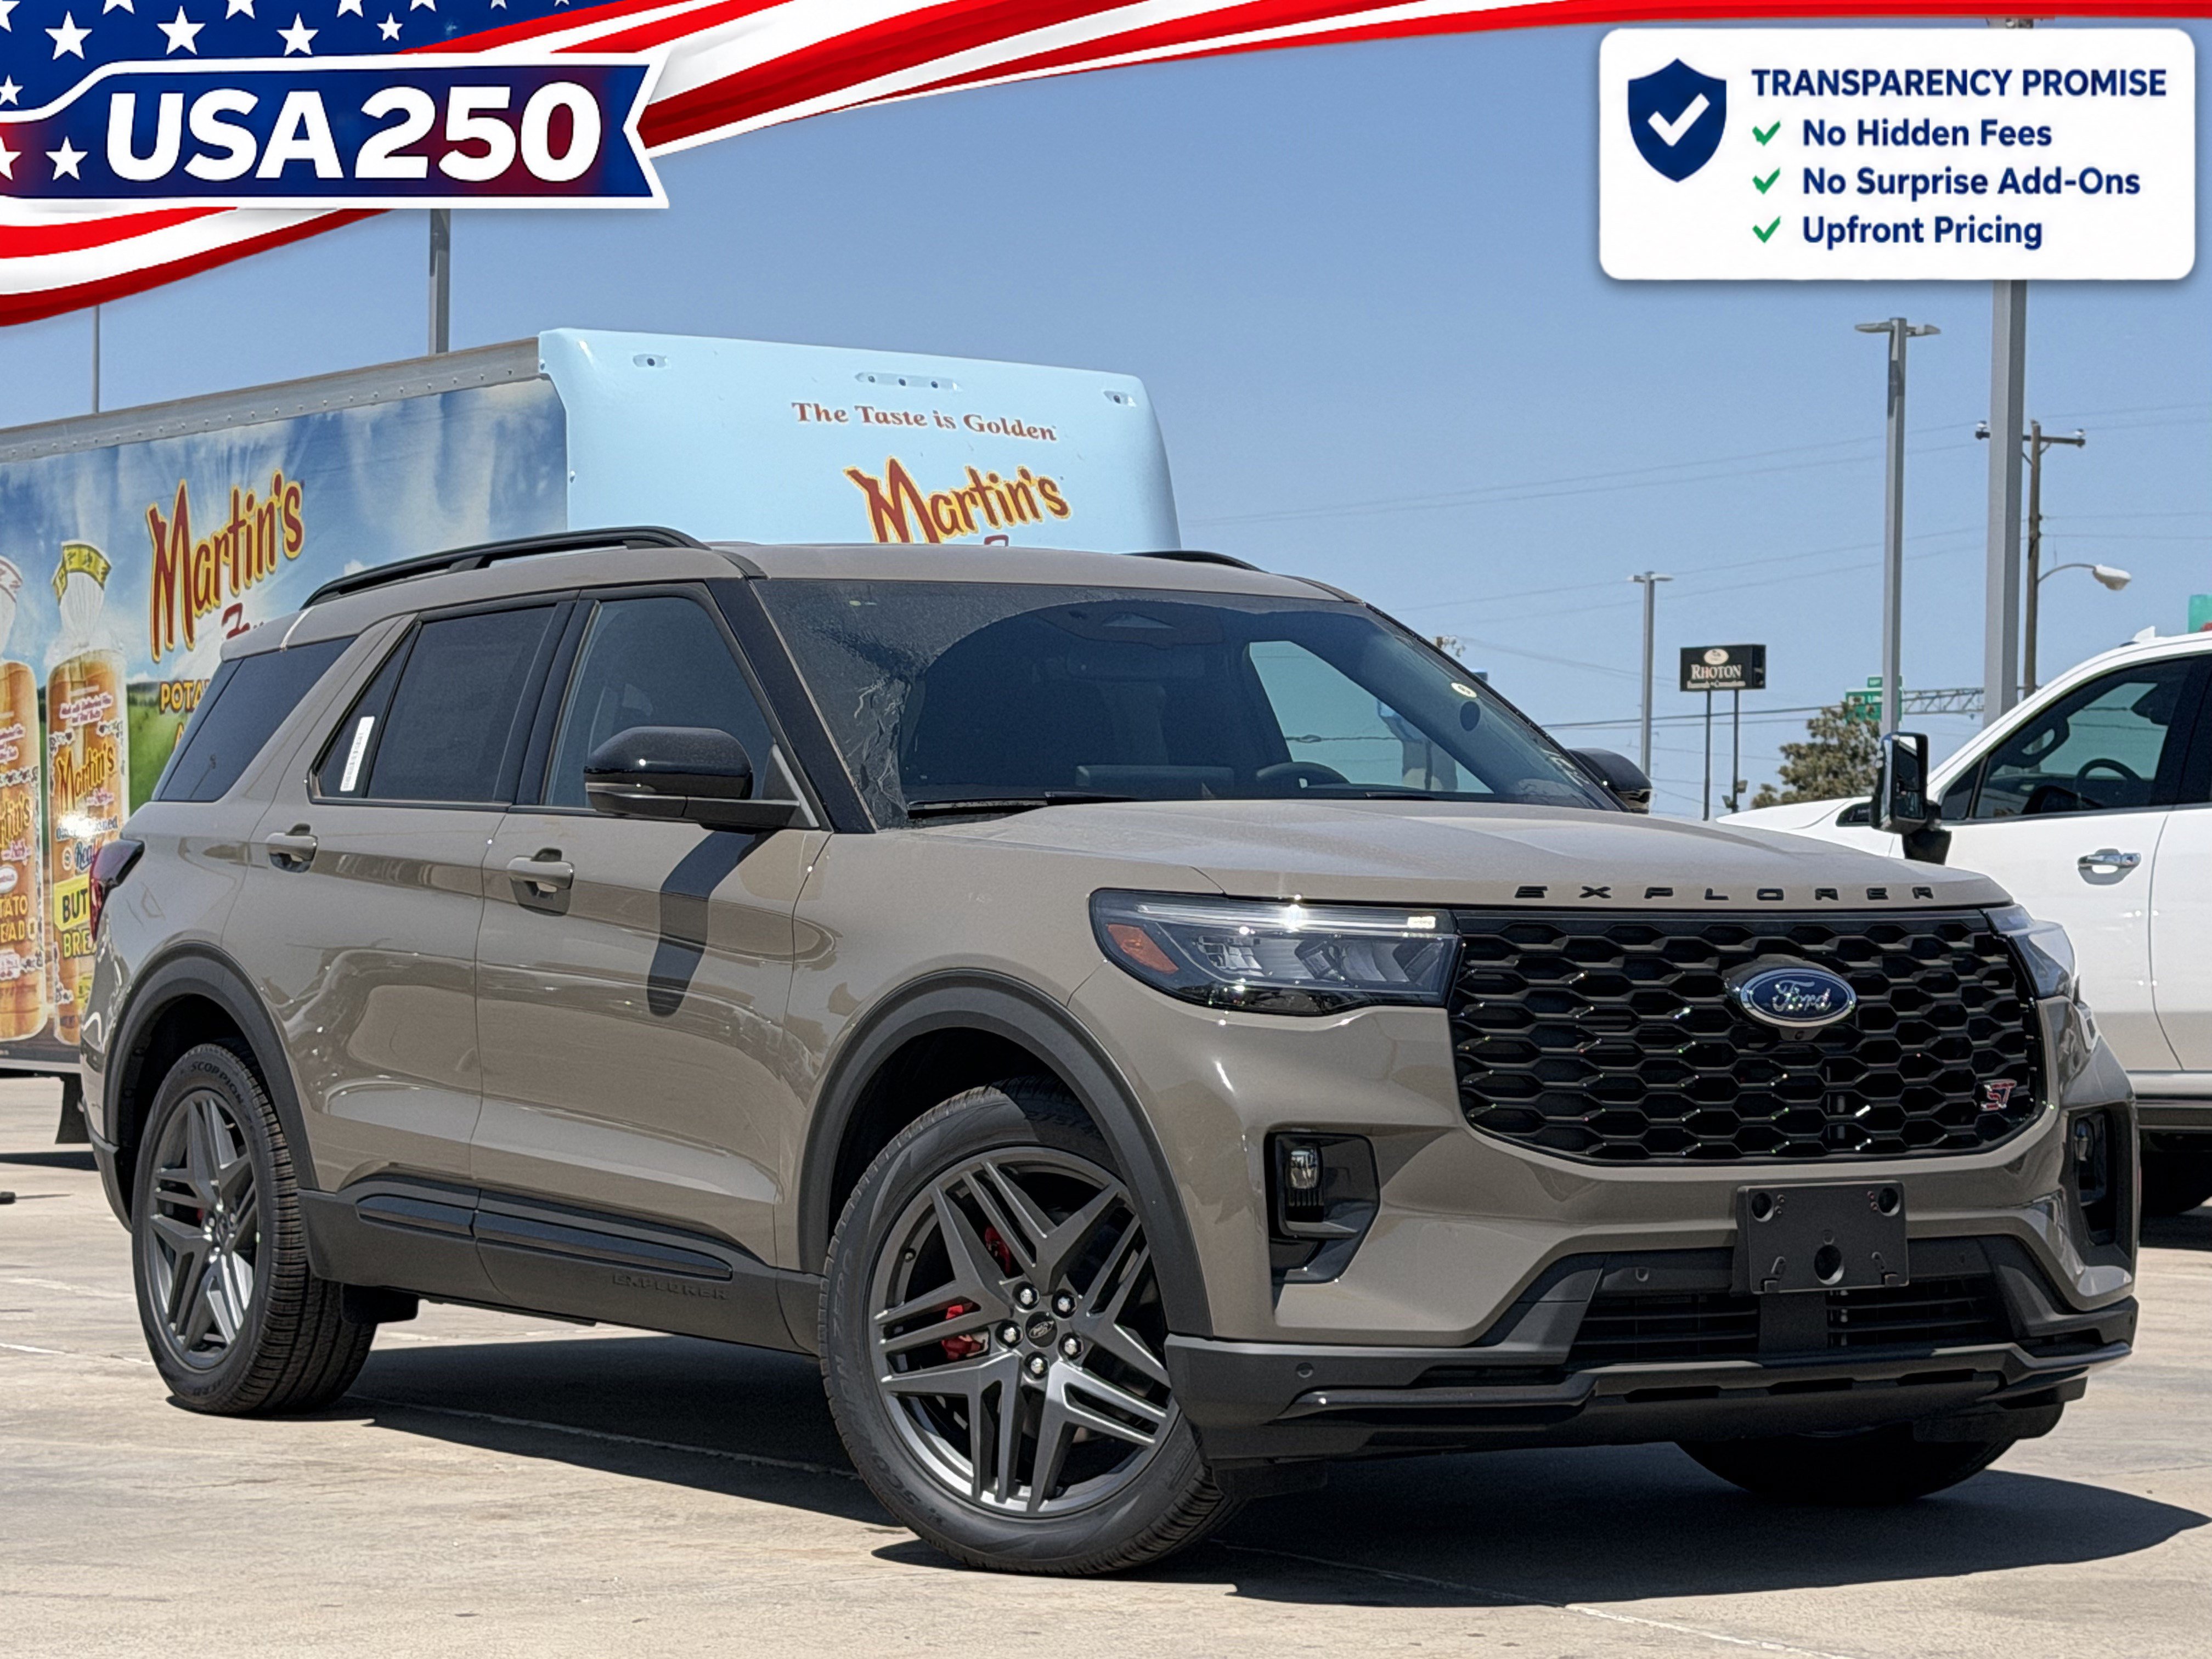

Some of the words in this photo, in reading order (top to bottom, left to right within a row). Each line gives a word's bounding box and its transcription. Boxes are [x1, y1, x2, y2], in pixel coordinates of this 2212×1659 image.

[792, 402, 848, 423] The
[854, 405, 927, 426] Taste
[933, 410, 957, 430] is
[963, 414, 1057, 441] Golden
[844, 456, 1071, 543] Martin's
[146, 469, 305, 663] Martin's
[1691, 664, 1742, 680] RHOTON
[1514, 885, 1934, 901] EXPLORER
[1773, 980, 1832, 1012] Ford
[1981, 1079, 2017, 1111] ST
[612, 1273, 730, 1301] EXPLORER
